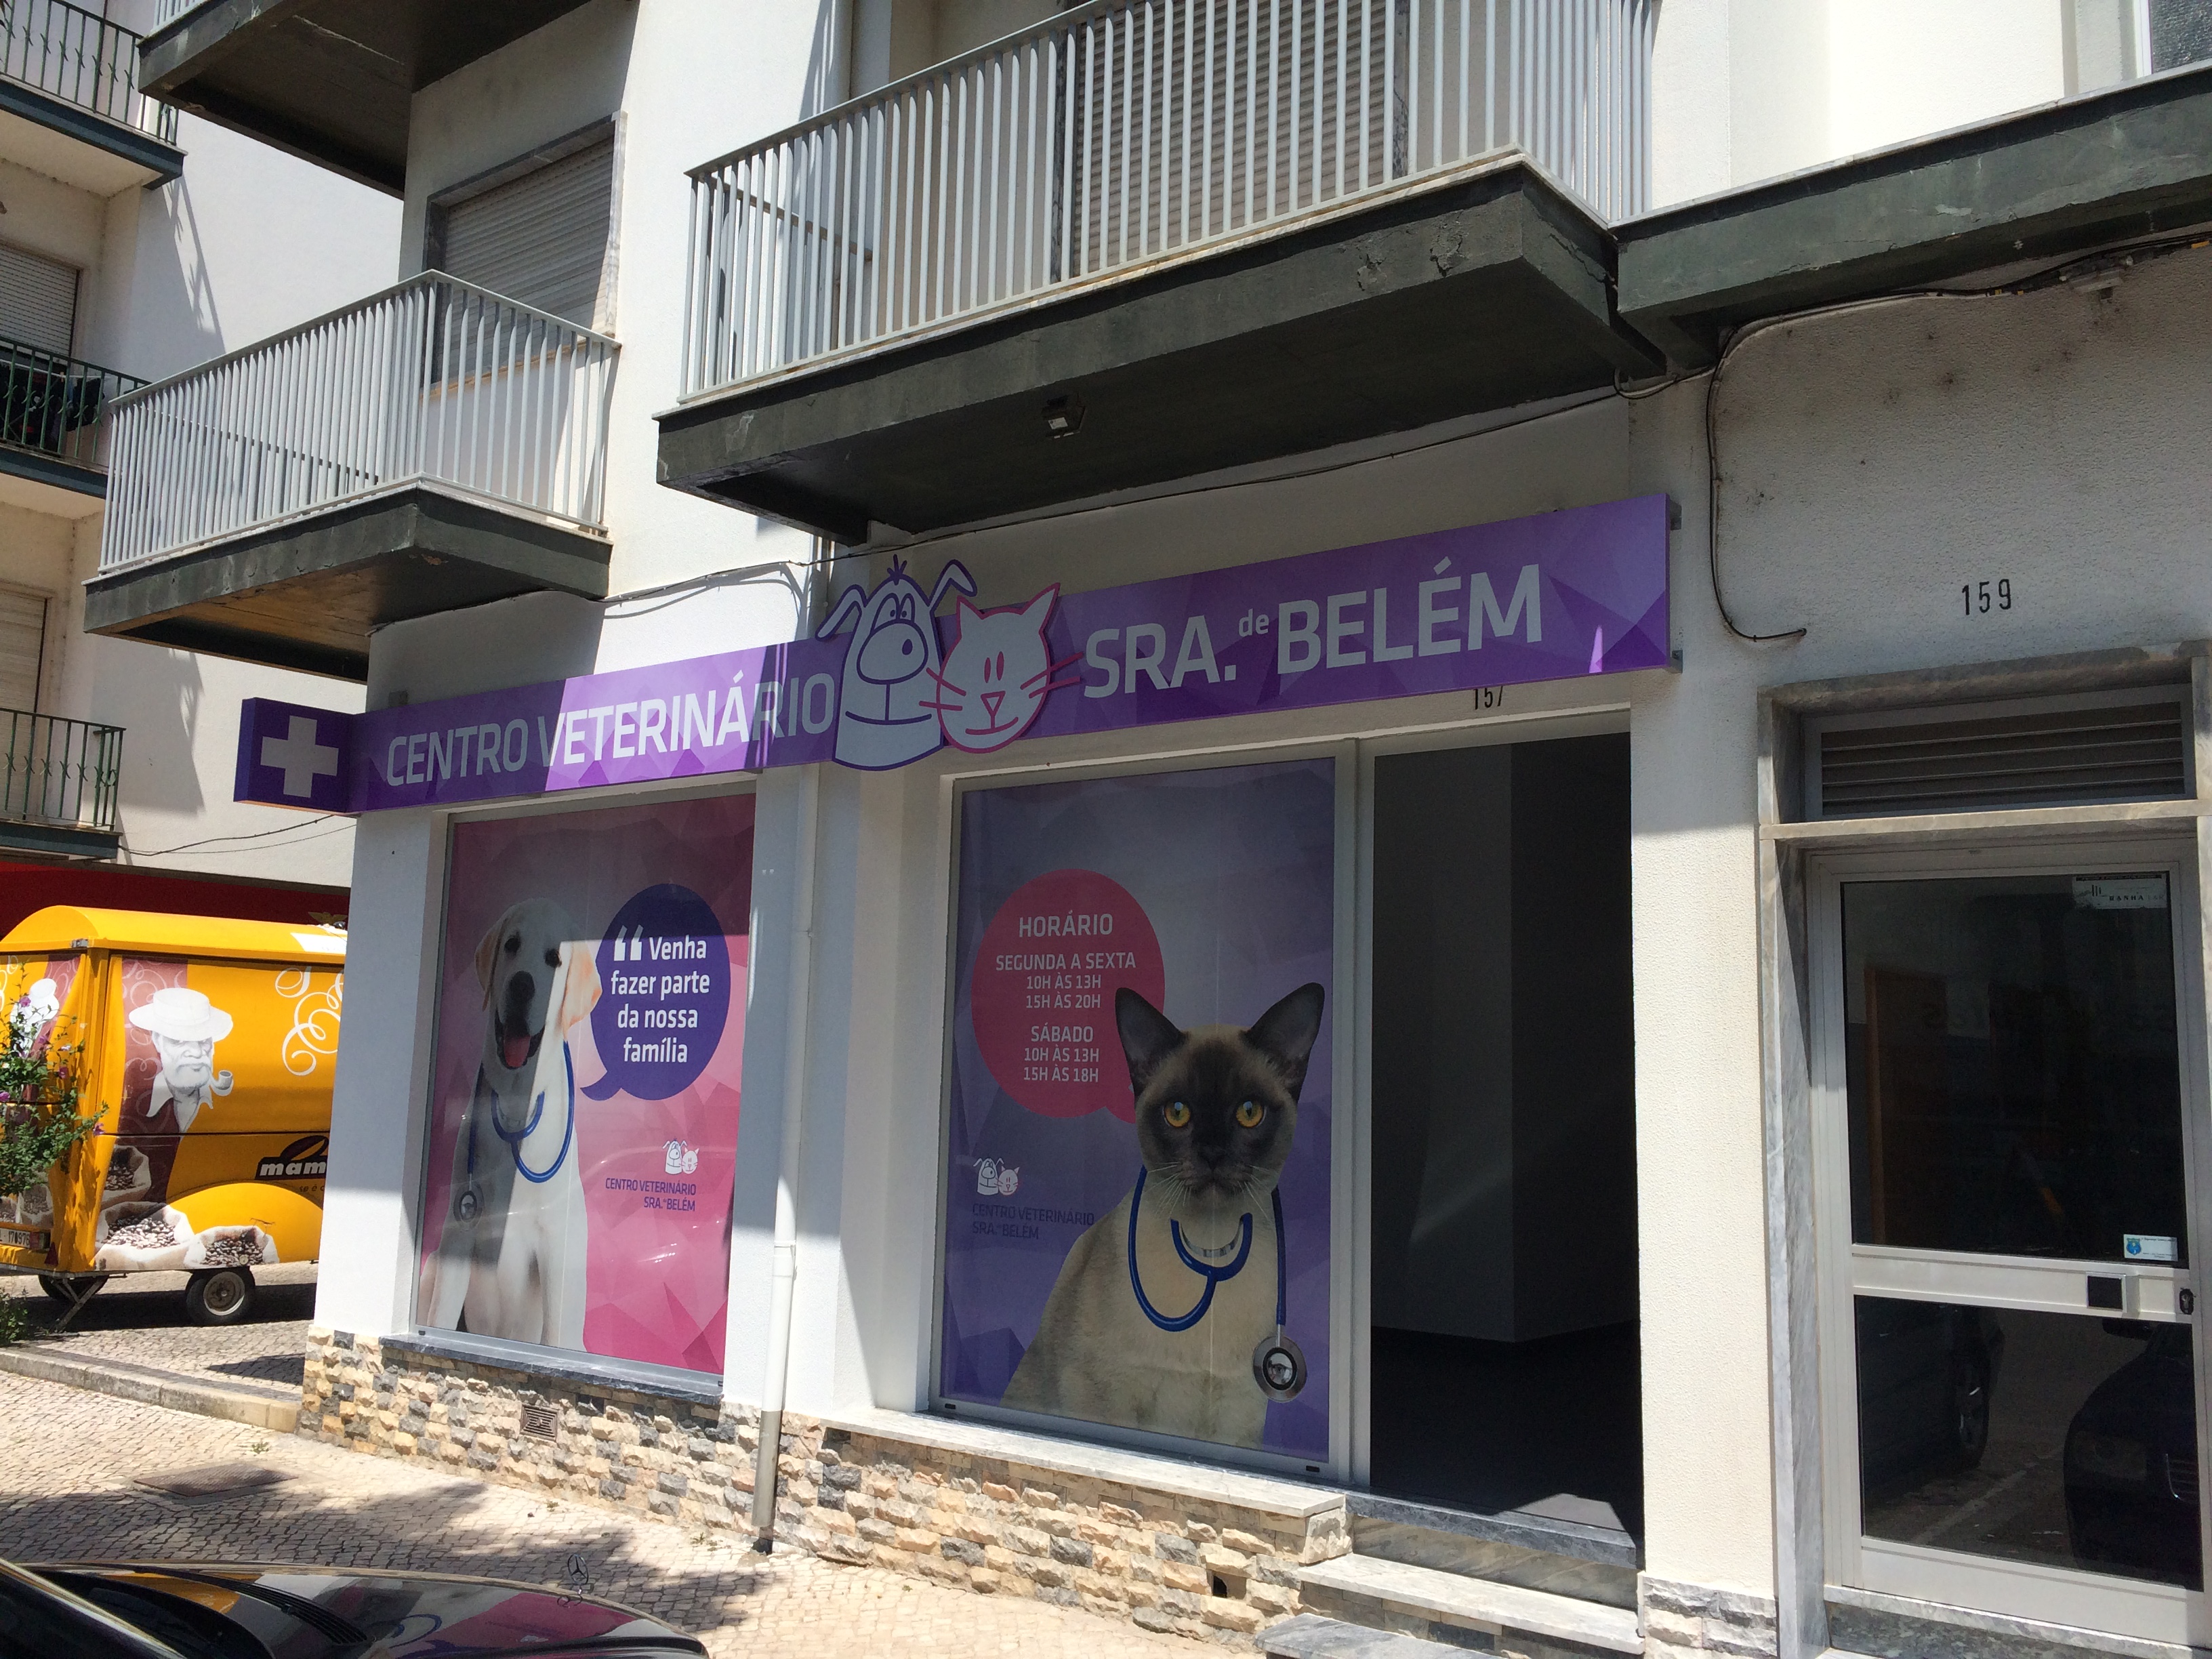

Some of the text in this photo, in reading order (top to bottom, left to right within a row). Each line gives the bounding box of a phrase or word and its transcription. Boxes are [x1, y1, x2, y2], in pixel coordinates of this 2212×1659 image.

[1962, 578, 2011, 615] 159
[1084, 556, 1542, 698] SRA. de BELÉM
[387, 670, 834, 786] CENTRO VETERINÁRIO
[1019, 909, 1113, 937] HORÁRIO
[649, 935, 706, 960] Venha
[996, 951, 1136, 970] SEGUNDA A SEXTA
[611, 970, 710, 1000] fazer parte
[1027, 972, 1101, 989] 10H ÀS 13H
[1026, 991, 1101, 1009] 15H ÀS 20H
[618, 1004, 698, 1028] da nossa
[1031, 1022, 1094, 1042] SÁBADO
[623, 1037, 688, 1063] família
[1024, 1044, 1099, 1062] 10H ÀS 13H
[1023, 1063, 1099, 1082] 15H ÀS 18H
[260, 1162, 327, 1176] mam
[605, 1177, 696, 1195] CENTRO VETERINÁRIO
[644, 1196, 695, 1211] SRA. BELÉM
[972, 1203, 1094, 1225] CENTRO VETERINÁRIO
[972, 1221, 1039, 1240] SRA. BELÉM
